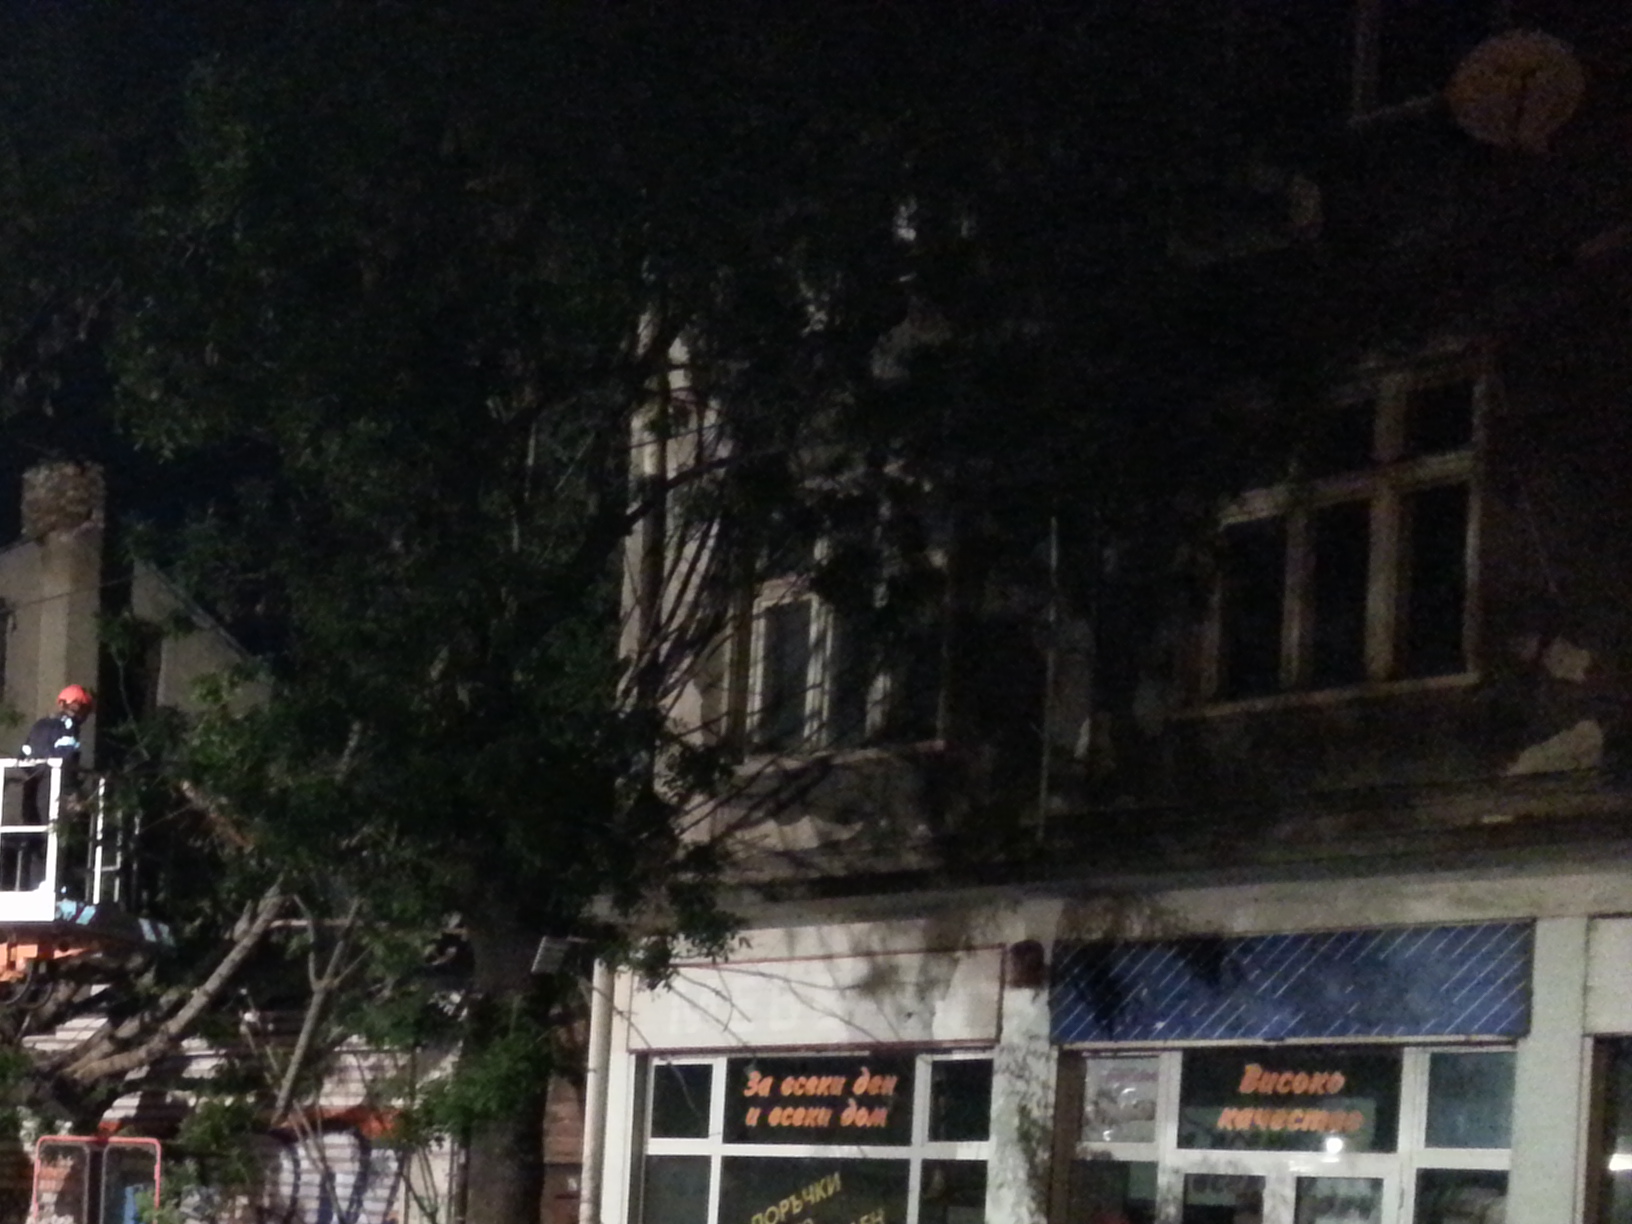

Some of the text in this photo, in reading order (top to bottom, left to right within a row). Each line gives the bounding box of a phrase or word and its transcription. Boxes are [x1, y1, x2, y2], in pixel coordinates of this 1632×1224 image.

[743, 1065, 898, 1098] За всеки ден
[1239, 1063, 1345, 1094] Високо
[746, 1097, 889, 1128] и всеки дом
[1217, 1107, 1364, 1131] качество
